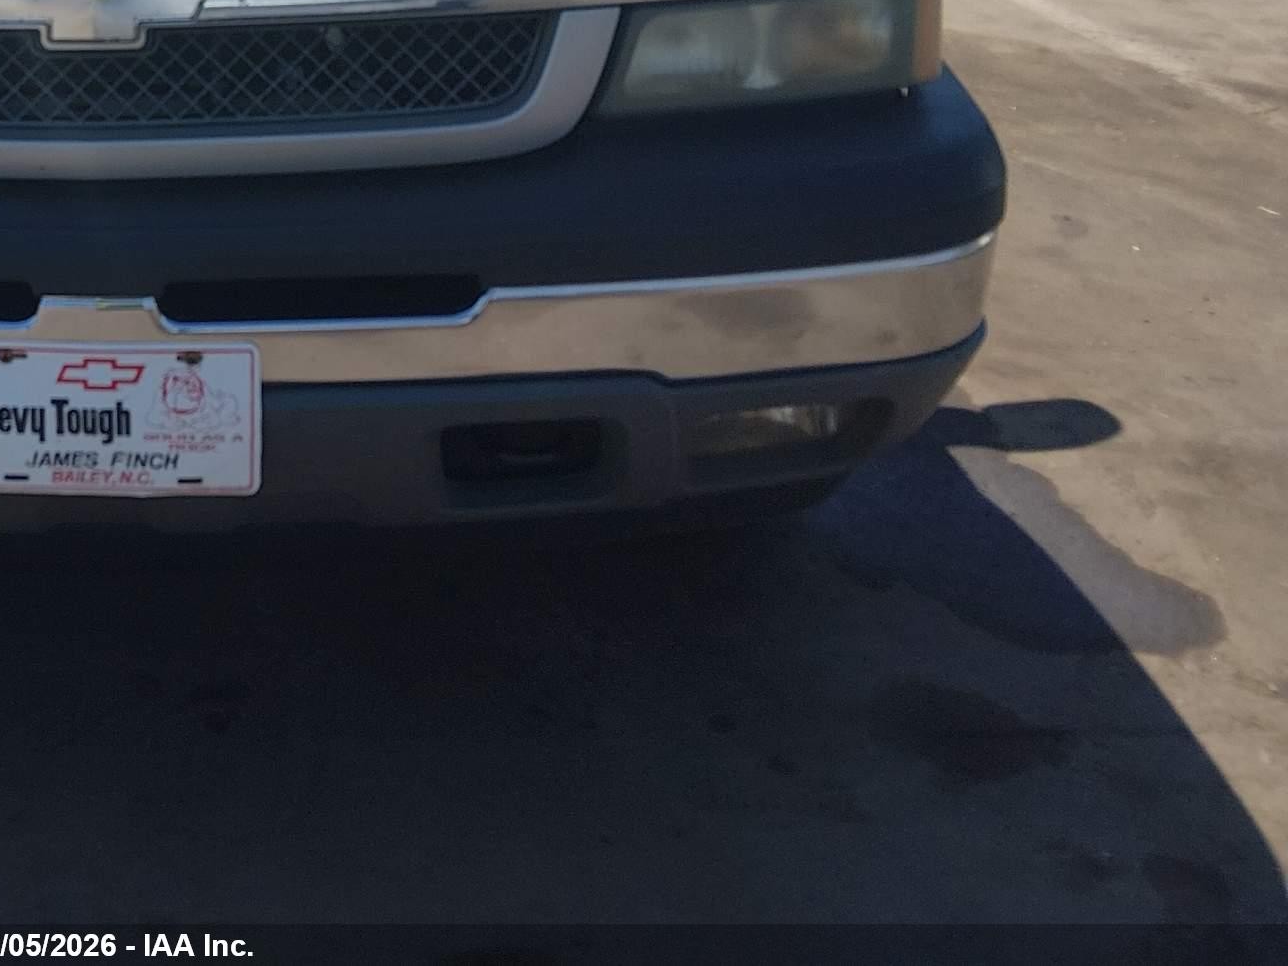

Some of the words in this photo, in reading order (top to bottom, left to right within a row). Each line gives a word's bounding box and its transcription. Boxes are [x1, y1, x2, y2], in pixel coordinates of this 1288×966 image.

[51, 399, 132, 444] Tough
[26, 449, 99, 468] JAMES
[111, 452, 179, 470] FINCH
